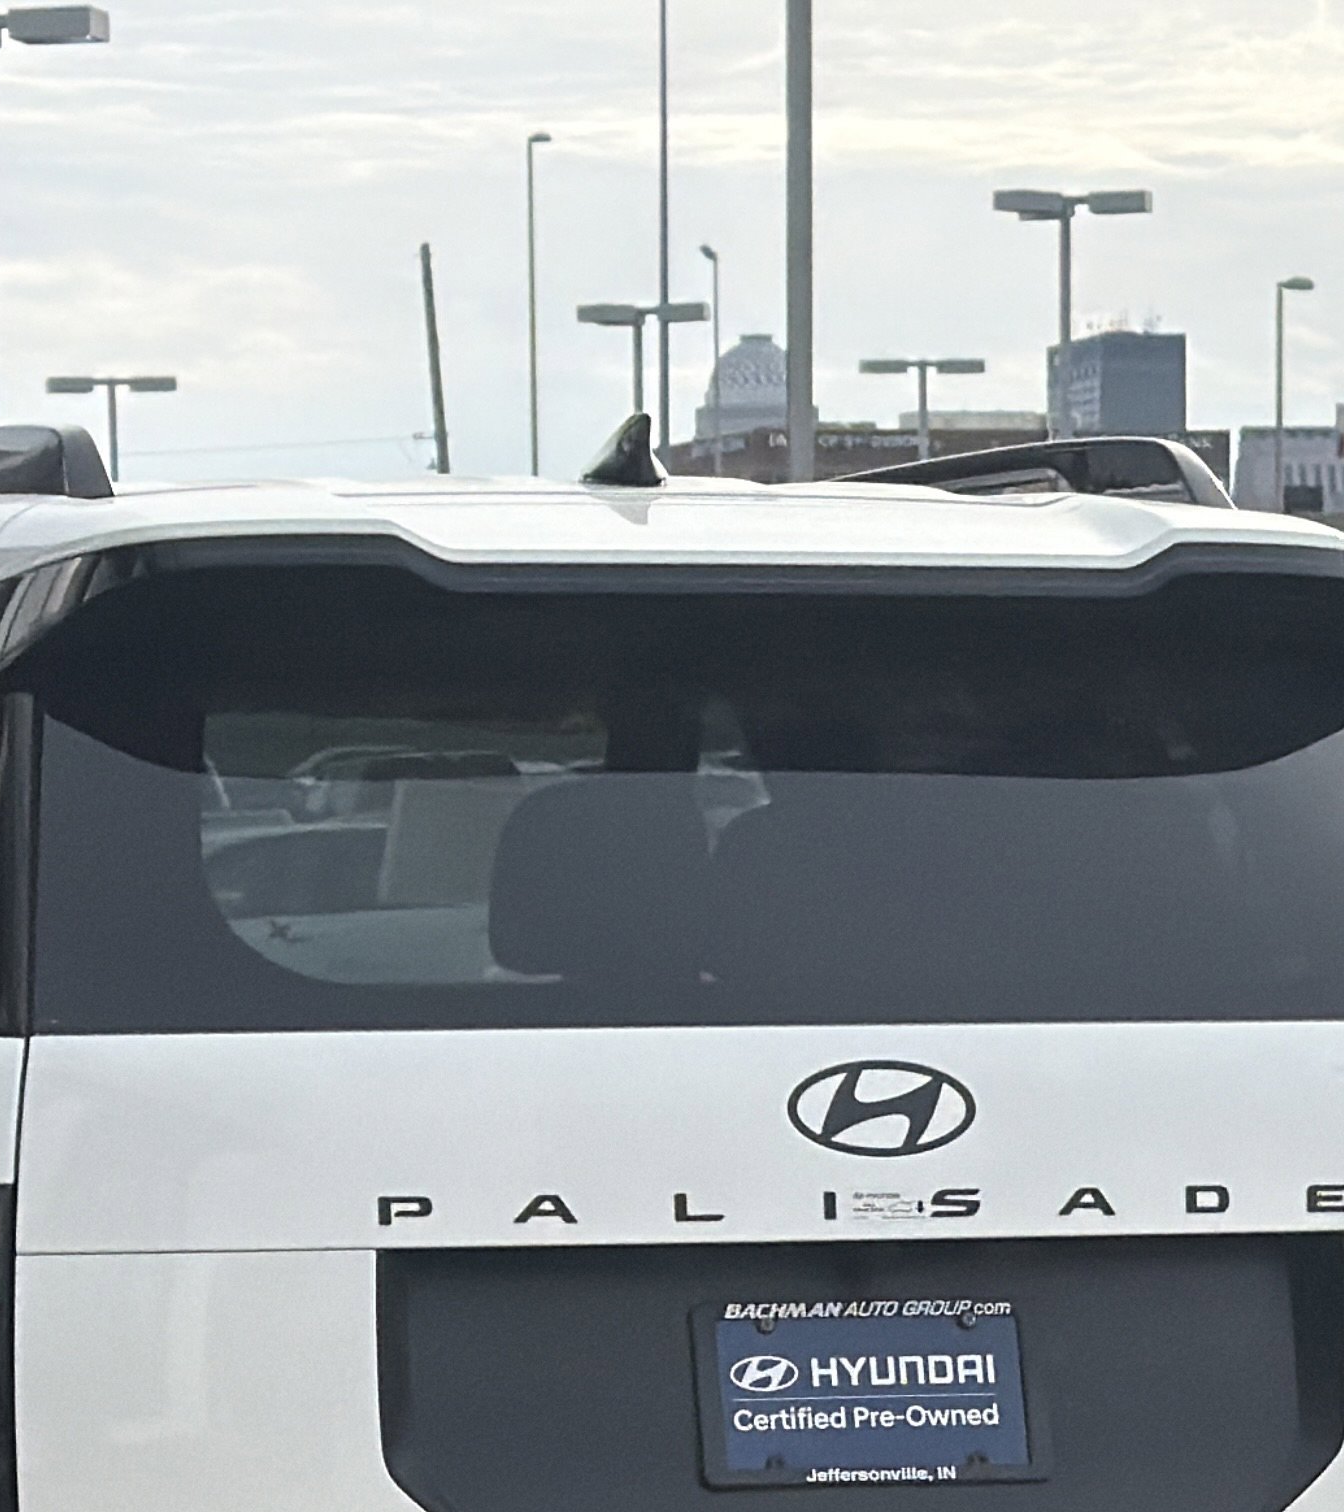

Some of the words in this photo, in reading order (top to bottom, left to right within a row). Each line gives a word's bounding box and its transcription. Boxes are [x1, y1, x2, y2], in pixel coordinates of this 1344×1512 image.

[724, 1302, 844, 1319] BACHMAN
[844, 1301, 899, 1317] AUTO
[810, 1354, 997, 1388] HYUNDAI
[733, 1406, 847, 1431] Certified
[853, 1402, 1000, 1428] Pre-Owned
[806, 1466, 933, 1482] Jeffersonville,
[937, 1465, 956, 1480] IN
